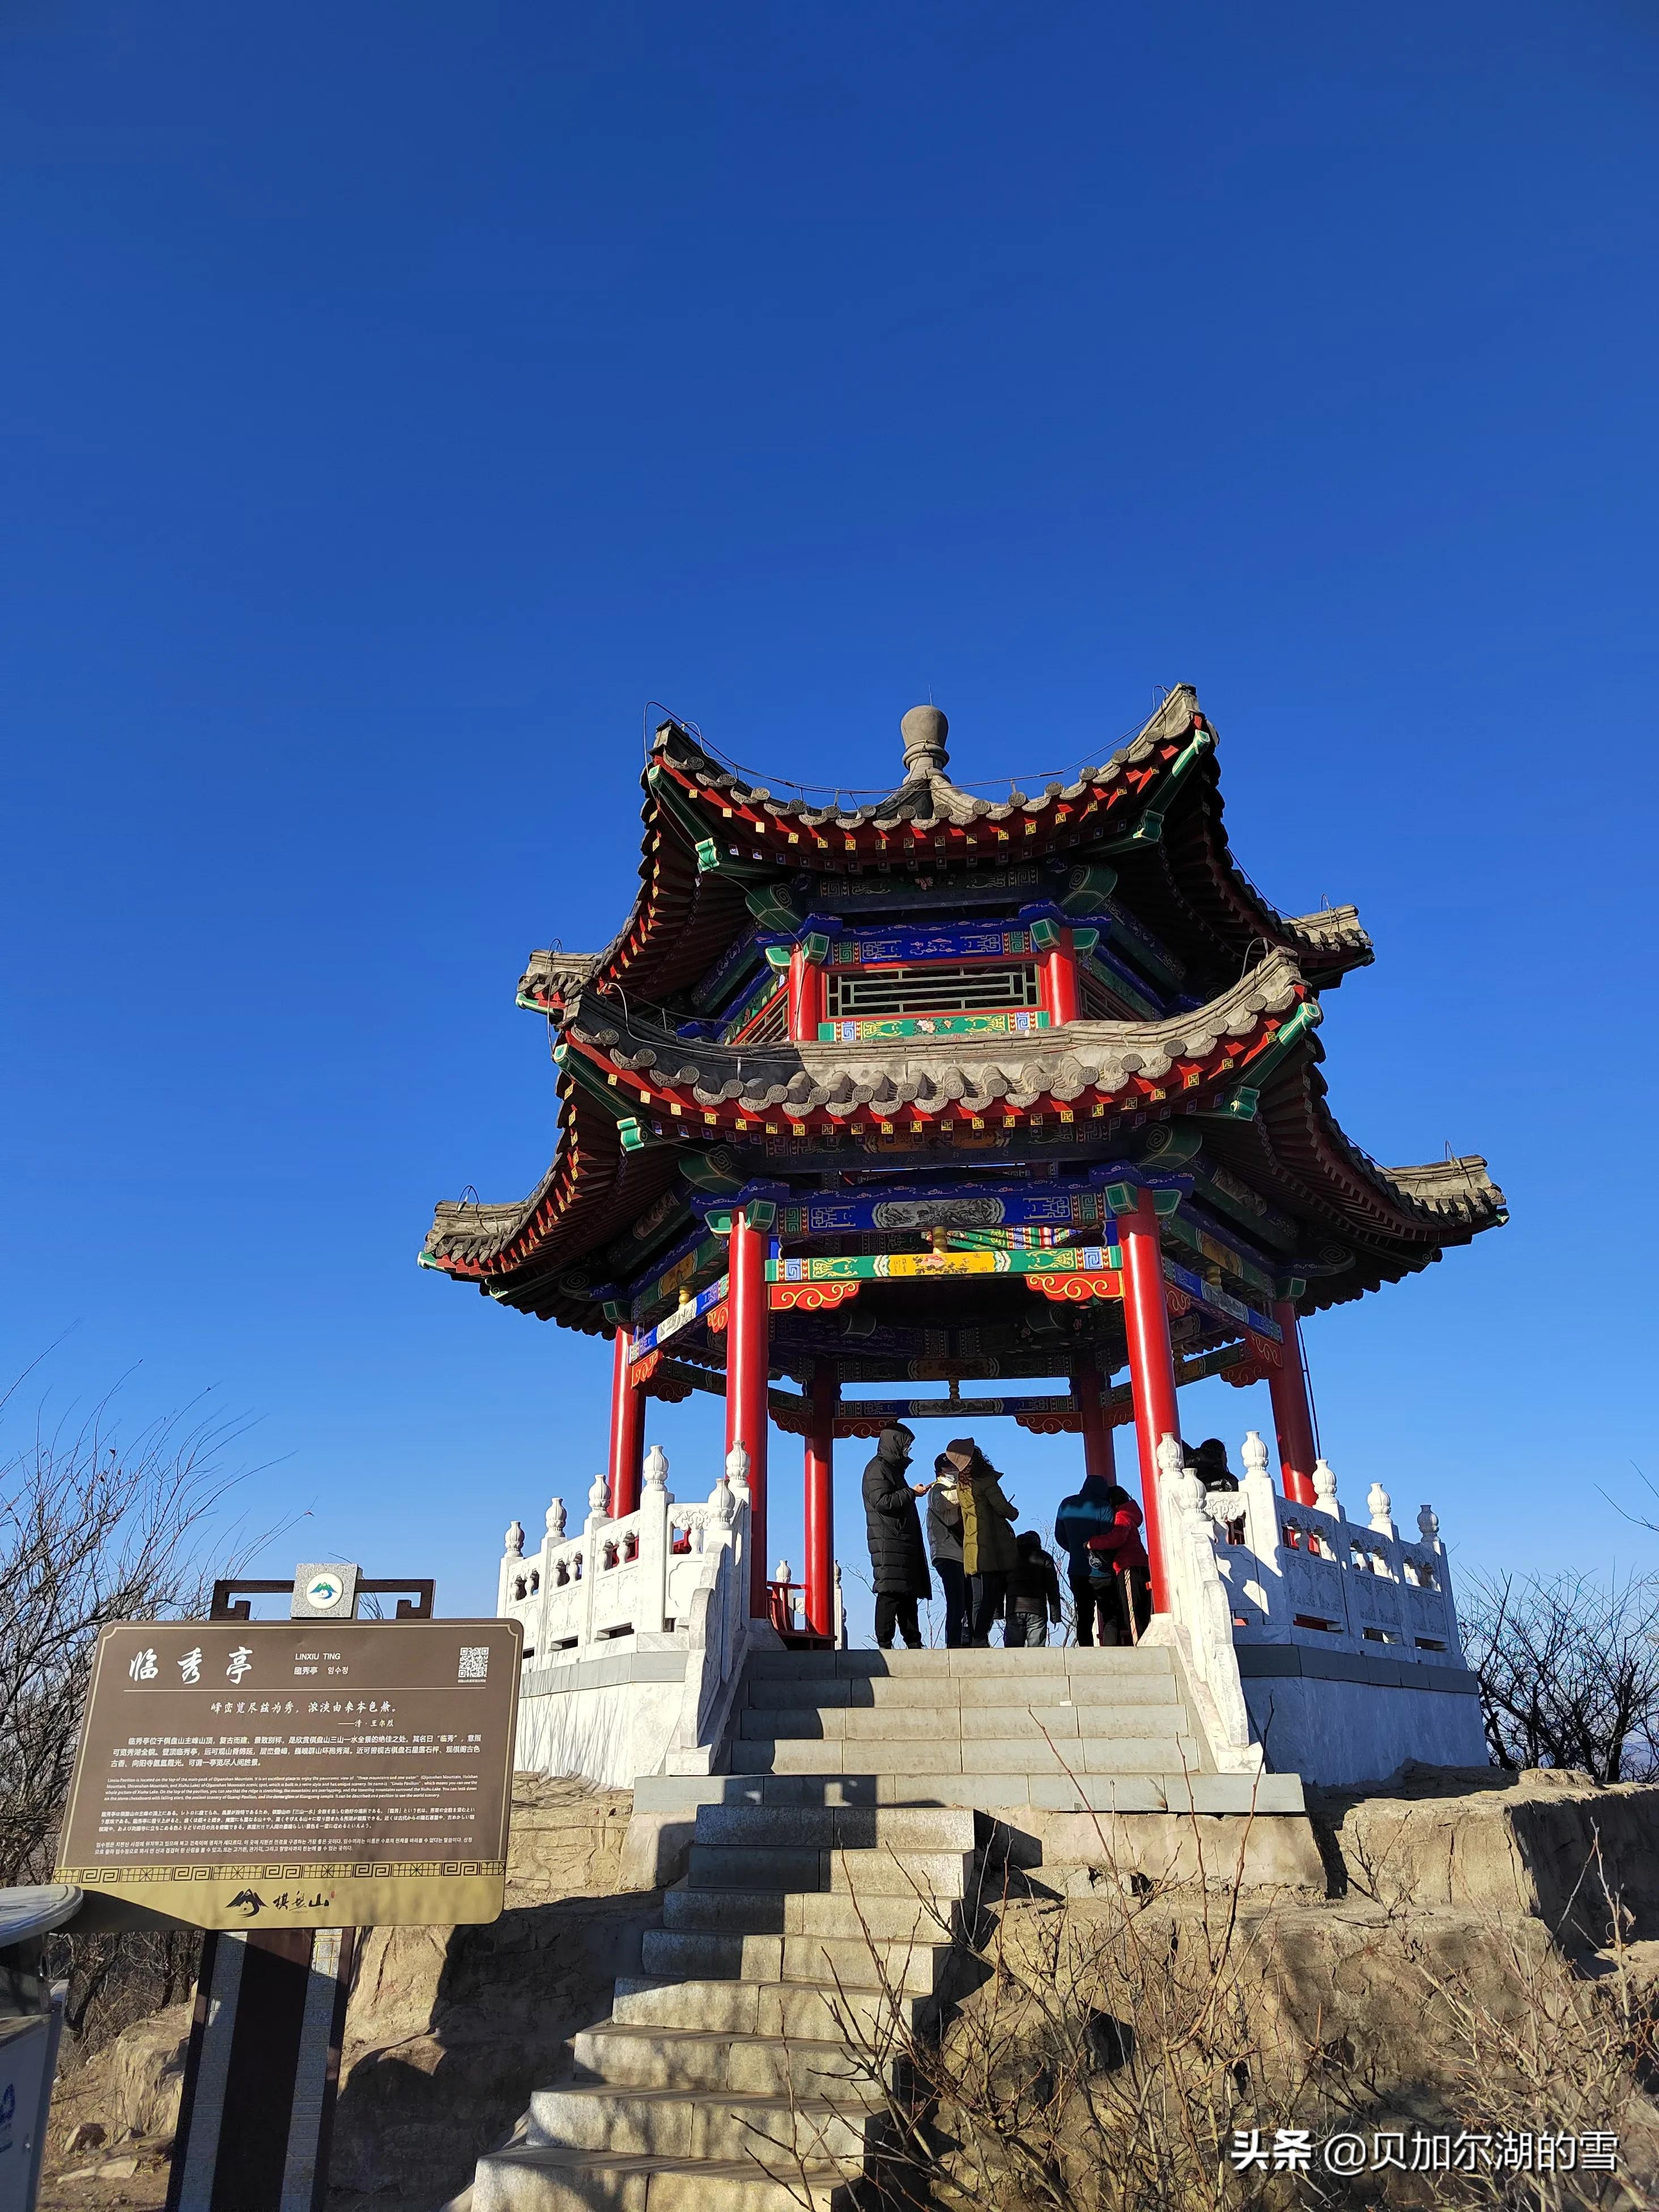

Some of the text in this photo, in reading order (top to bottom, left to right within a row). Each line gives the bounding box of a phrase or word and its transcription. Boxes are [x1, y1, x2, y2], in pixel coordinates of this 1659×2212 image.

[129, 1647, 253, 1684] 临秀亭
[327, 1666, 348, 1674] 임수정
[273, 1890, 330, 1911] 棋盘山
